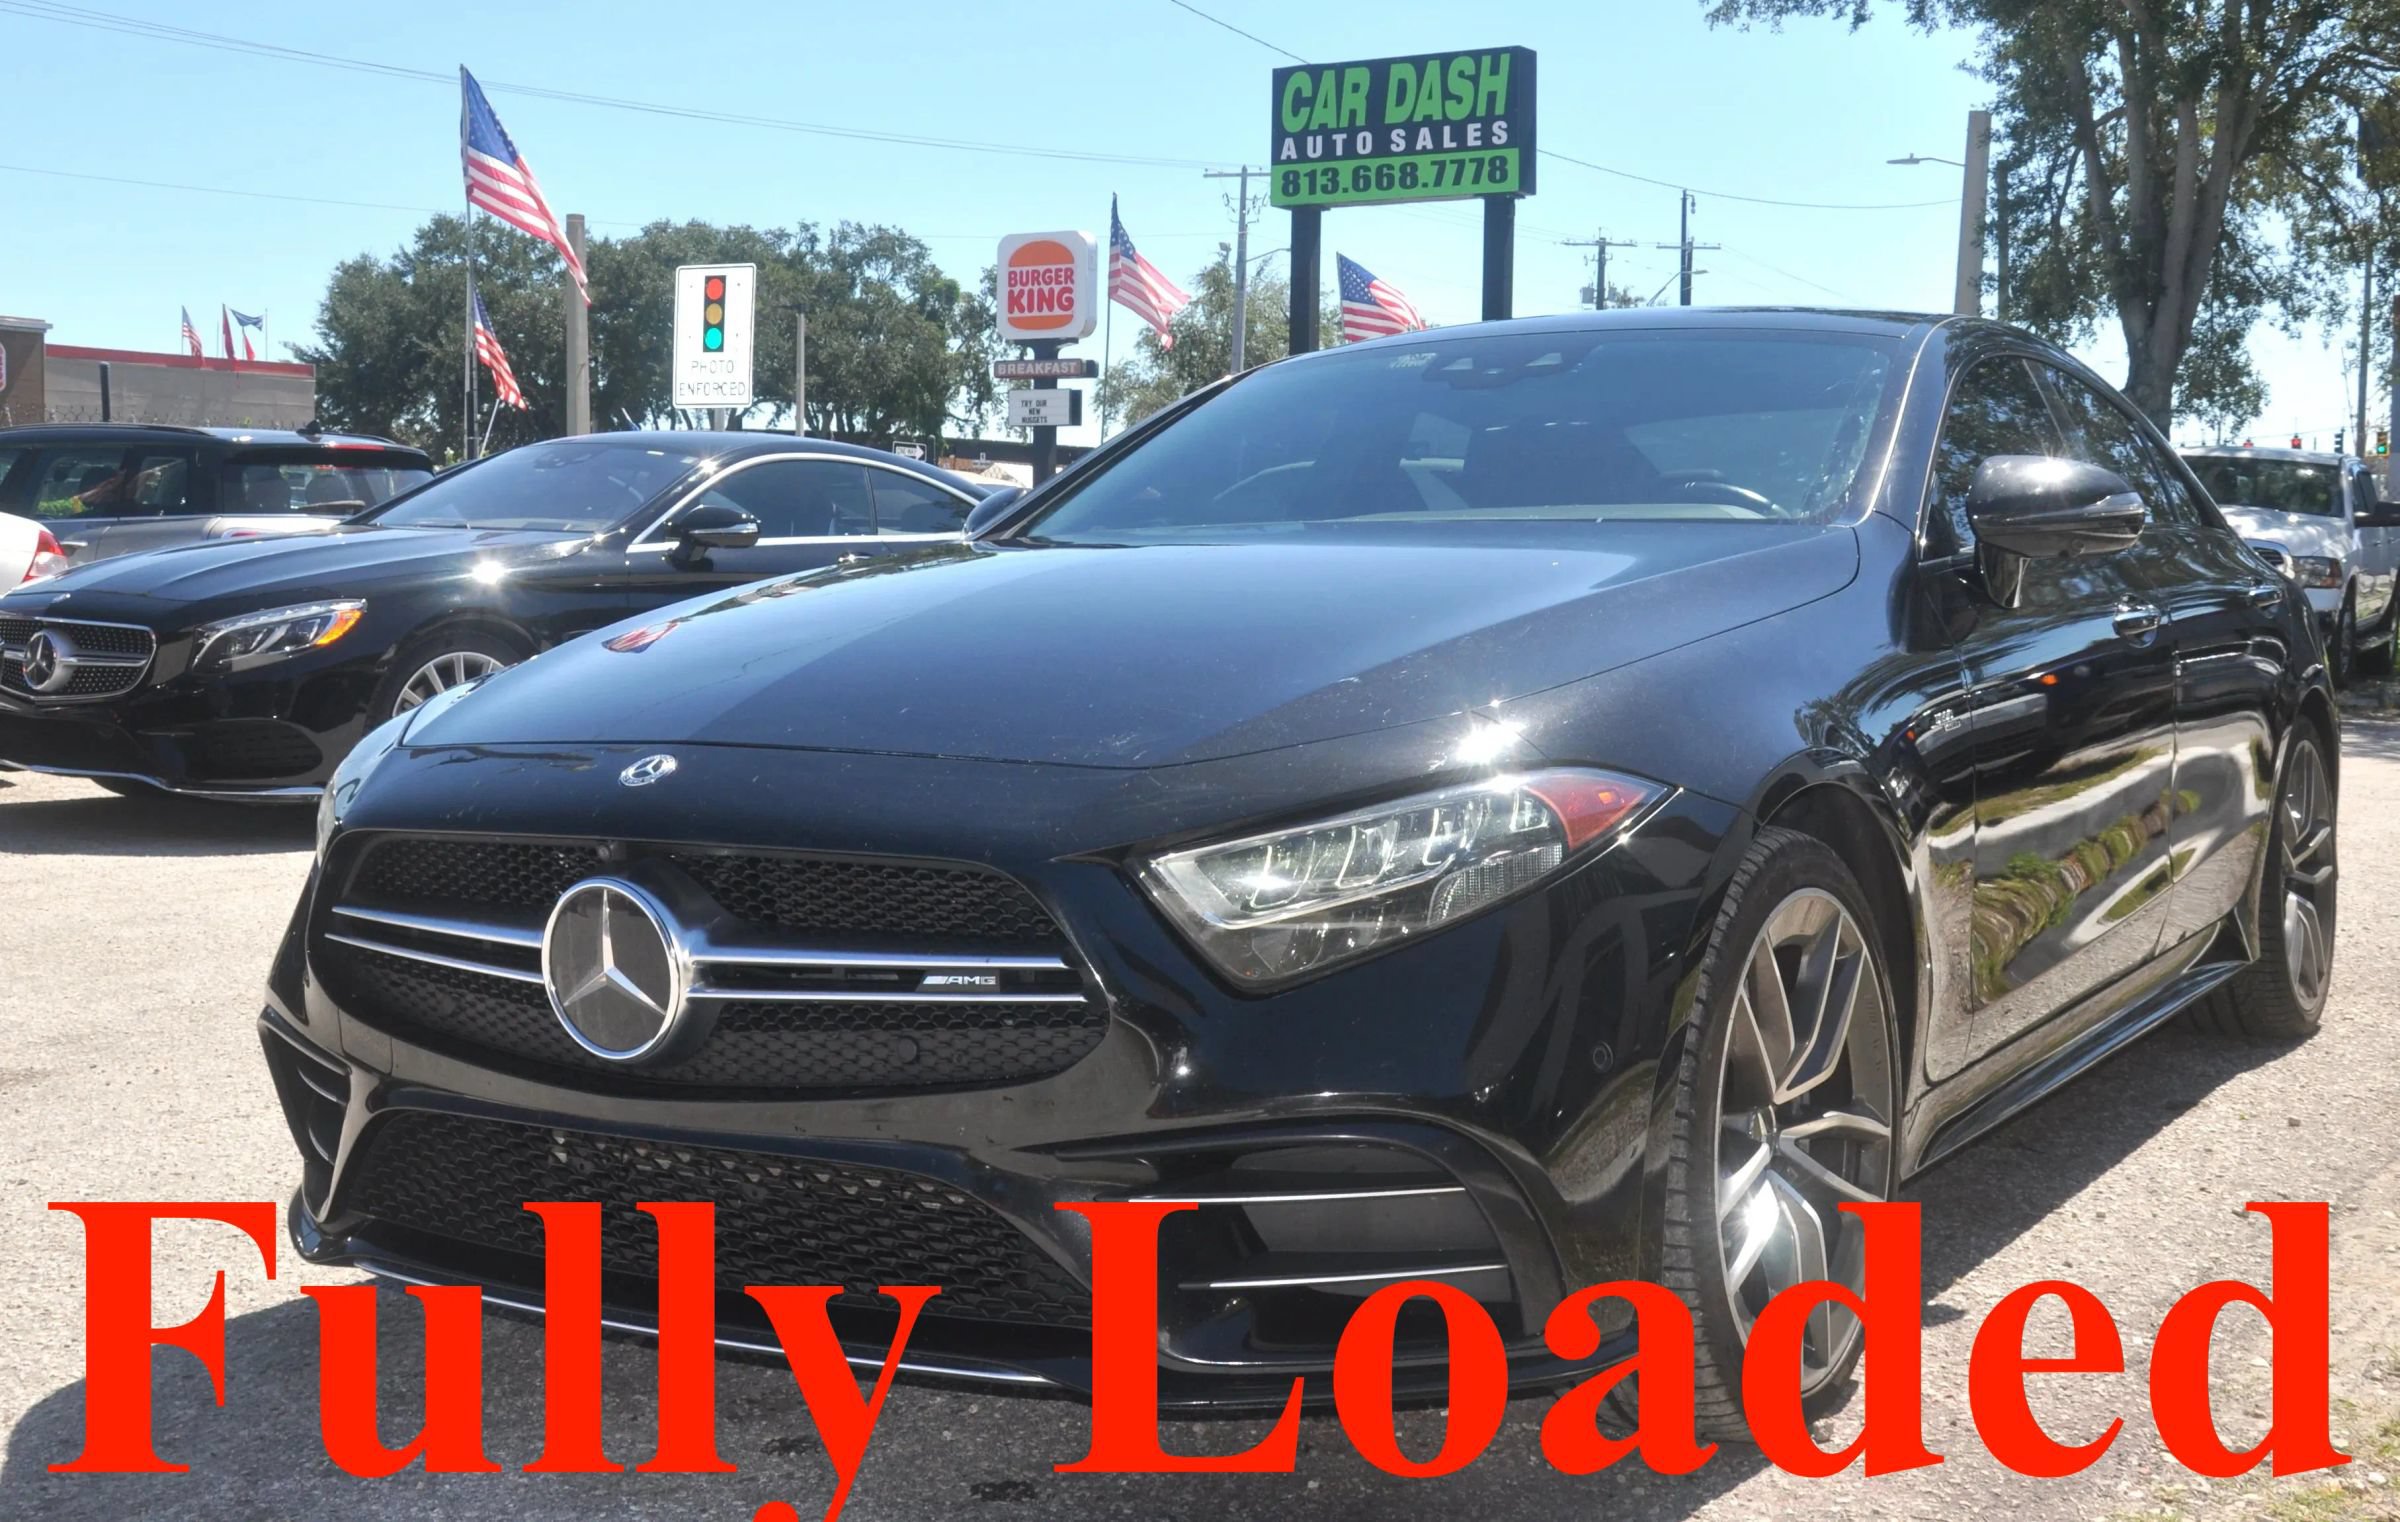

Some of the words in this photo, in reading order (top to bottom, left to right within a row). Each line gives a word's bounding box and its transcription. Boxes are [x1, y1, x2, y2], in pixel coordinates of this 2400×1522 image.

[1281, 66, 1371, 134] CAR
[1384, 53, 1511, 124] DASH
[1280, 132, 1373, 160] AUTO
[1390, 120, 1508, 153] SALES
[1281, 155, 1509, 198] 813.668.7778
[1007, 267, 1075, 288] BURGER
[1007, 286, 1075, 314] KING
[691, 360, 734, 374] PHOTO
[997, 361, 1078, 375] BREAKFAST
[679, 382, 746, 396] ENFORCED
[1021, 416, 1048, 424] NUGGETS
[945, 975, 997, 985] AMG
